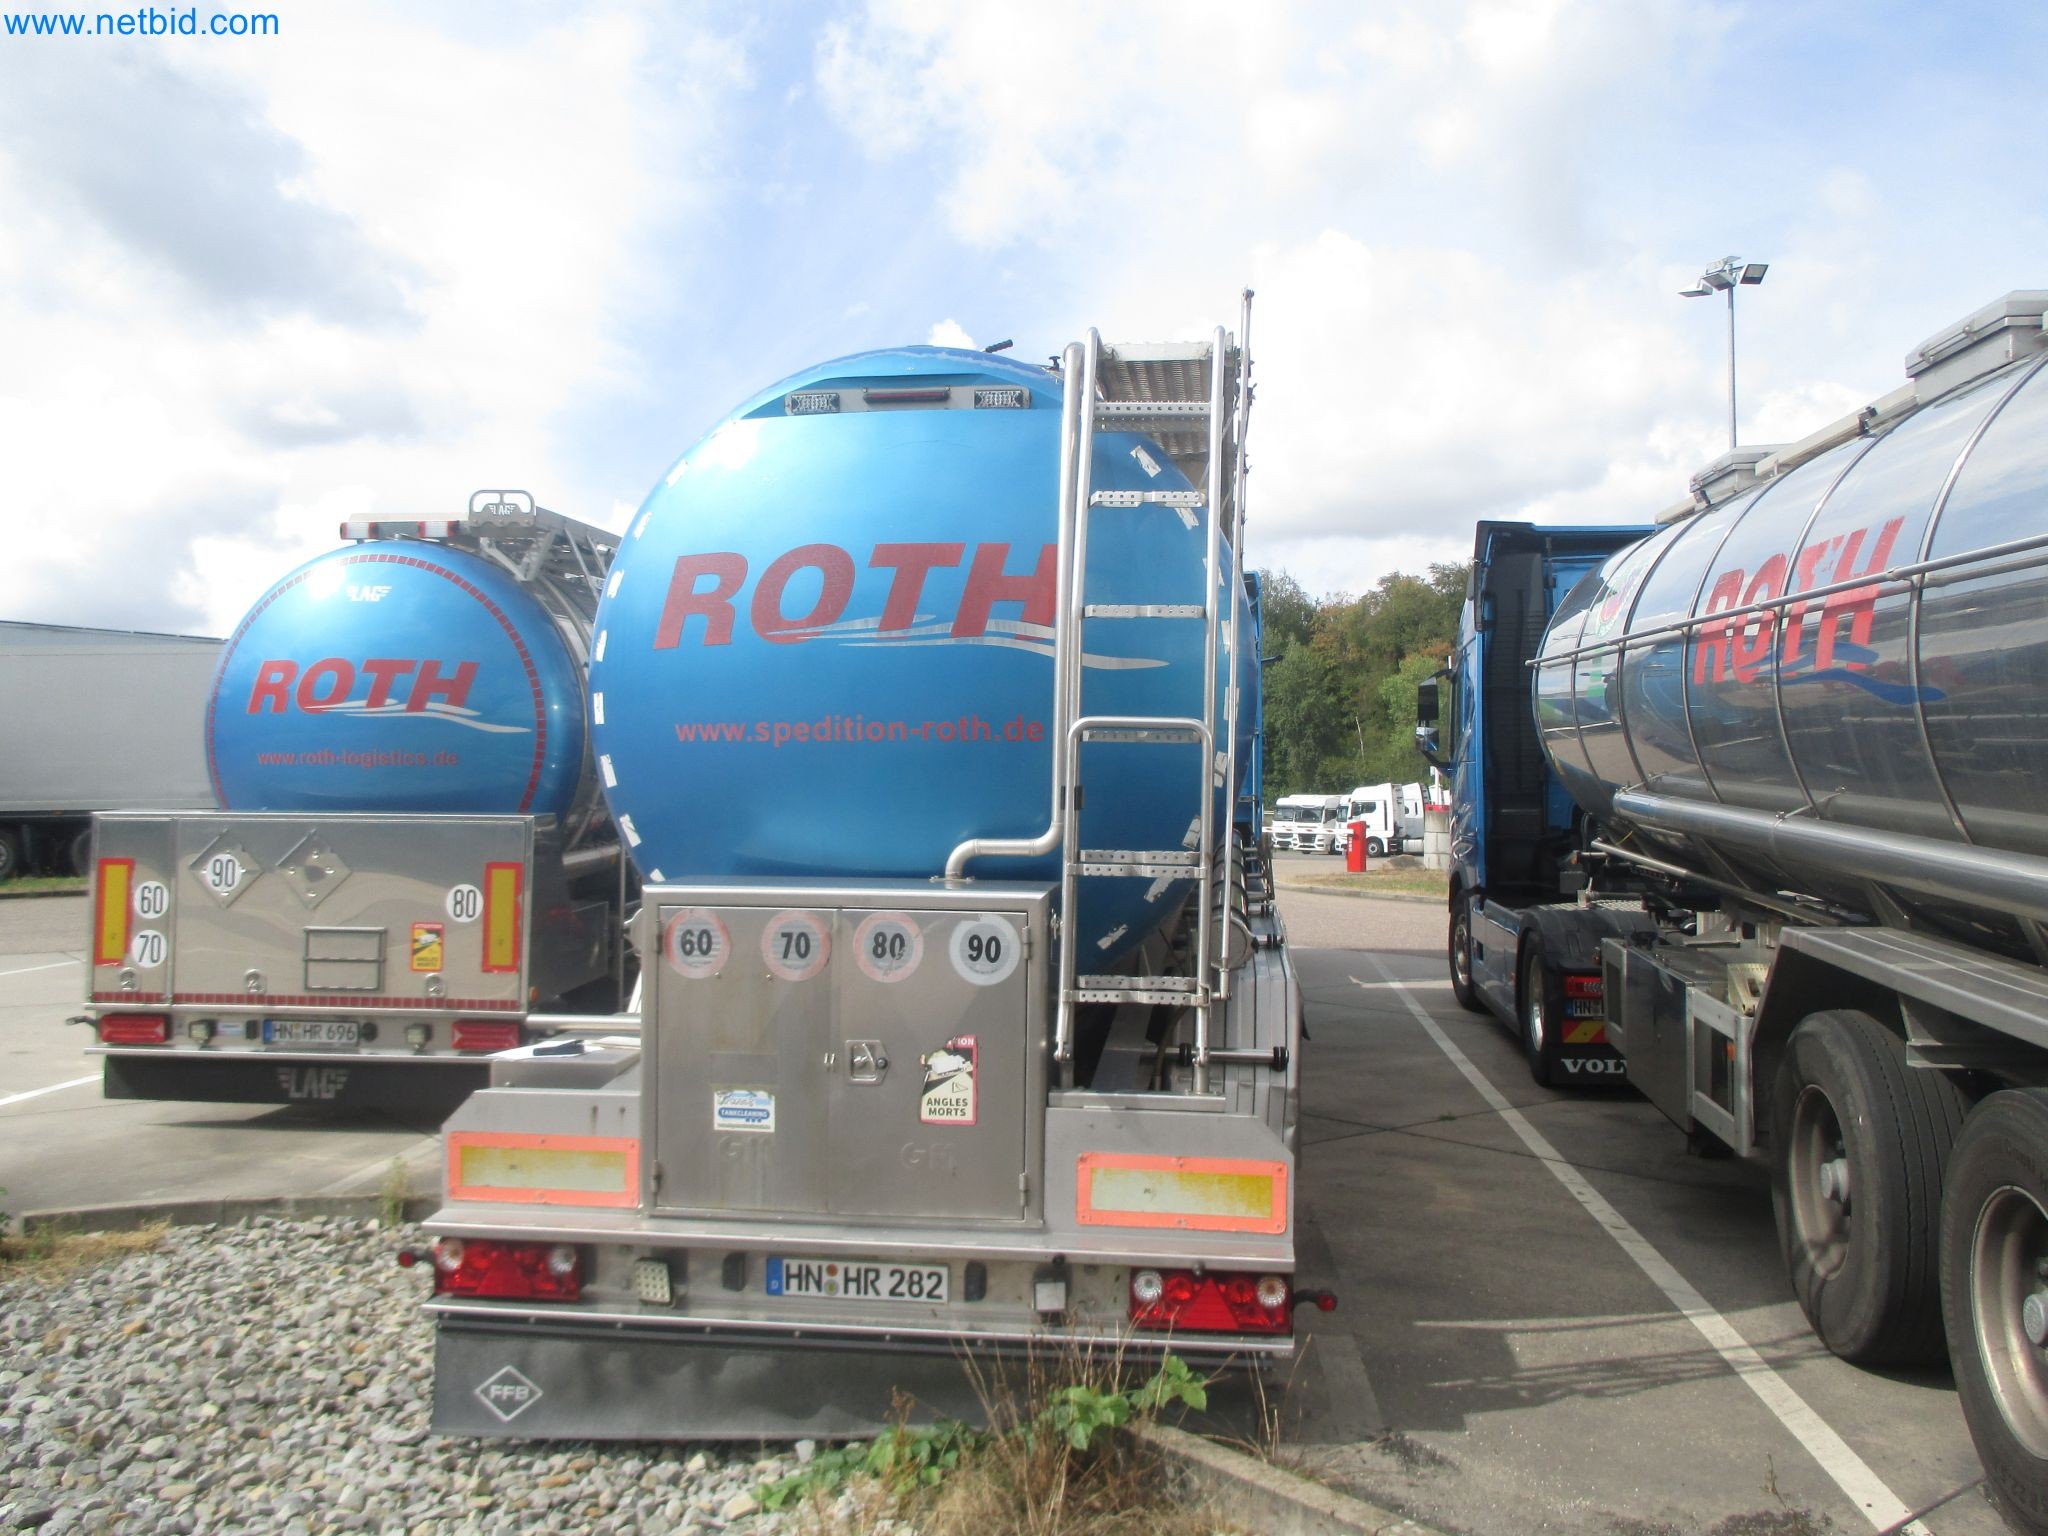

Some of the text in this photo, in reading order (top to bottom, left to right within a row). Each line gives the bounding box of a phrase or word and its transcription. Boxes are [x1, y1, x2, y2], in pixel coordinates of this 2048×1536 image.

[653, 543, 1057, 651] ROTH
[246, 658, 480, 714] ROTH
[674, 714, 1046, 749] www.spedition-roth.de
[257, 749, 460, 768] www.roth-logistics.de
[212, 858, 236, 887] 90
[140, 885, 164, 914] 60
[453, 889, 477, 918] 80
[138, 935, 161, 963] 70
[680, 928, 713, 956] 60
[780, 932, 811, 959] 70
[872, 931, 906, 960] 80
[967, 934, 1001, 963] 90
[272, 1024, 356, 1041] HN HR 696
[1561, 1058, 1628, 1074] VOL
[926, 1097, 969, 1108] ANGLES
[928, 1107, 967, 1117] MORTS
[785, 1263, 943, 1299] HN HR 282
[489, 1385, 529, 1400] FFB
